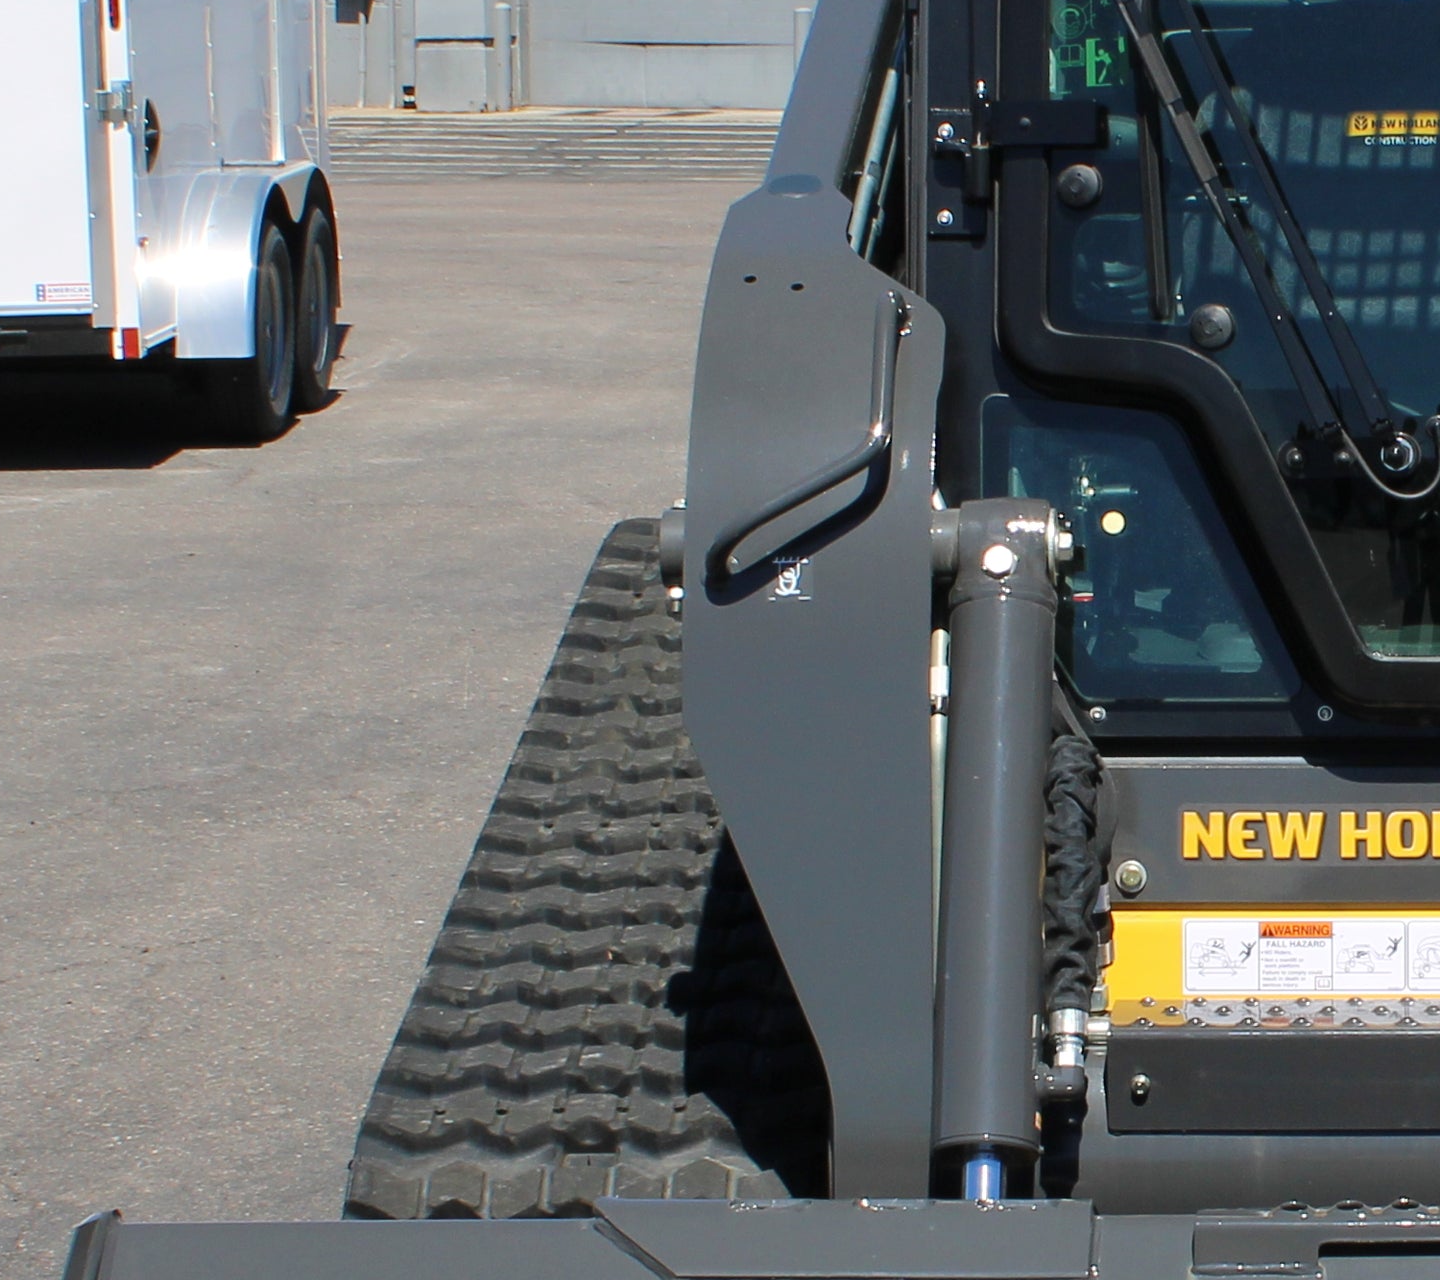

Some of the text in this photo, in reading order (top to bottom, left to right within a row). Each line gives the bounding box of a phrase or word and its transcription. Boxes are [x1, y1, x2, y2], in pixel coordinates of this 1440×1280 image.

[1371, 119, 1396, 128] NEW
[1364, 136, 1438, 145] CONSTRUCTION
[1181, 810, 1326, 859] NEW
[1274, 925, 1330, 936] WARNING
[1266, 940, 1326, 948] FALL HAZARD
